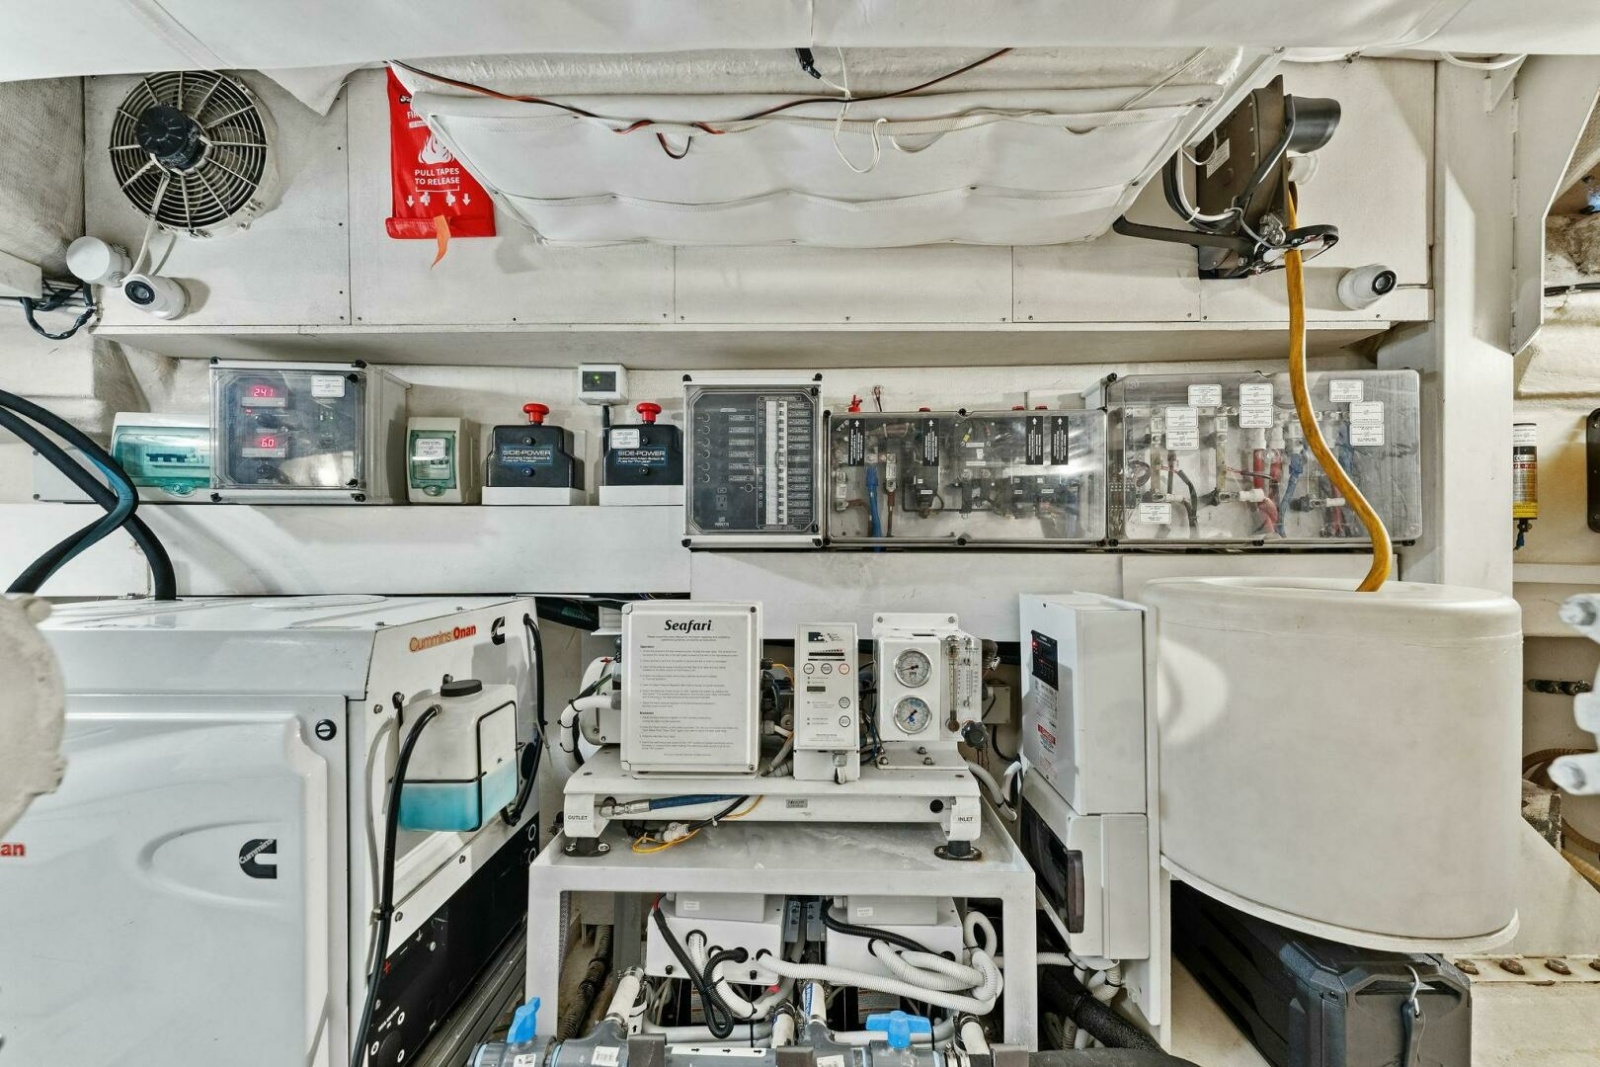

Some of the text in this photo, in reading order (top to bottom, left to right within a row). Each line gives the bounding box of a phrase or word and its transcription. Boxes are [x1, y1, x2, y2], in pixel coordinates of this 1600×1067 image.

[415, 176, 460, 185] TO RELEASE
[664, 619, 712, 633] Seafari
[409, 630, 452, 652] Cummins
[453, 624, 477, 640] Onan
